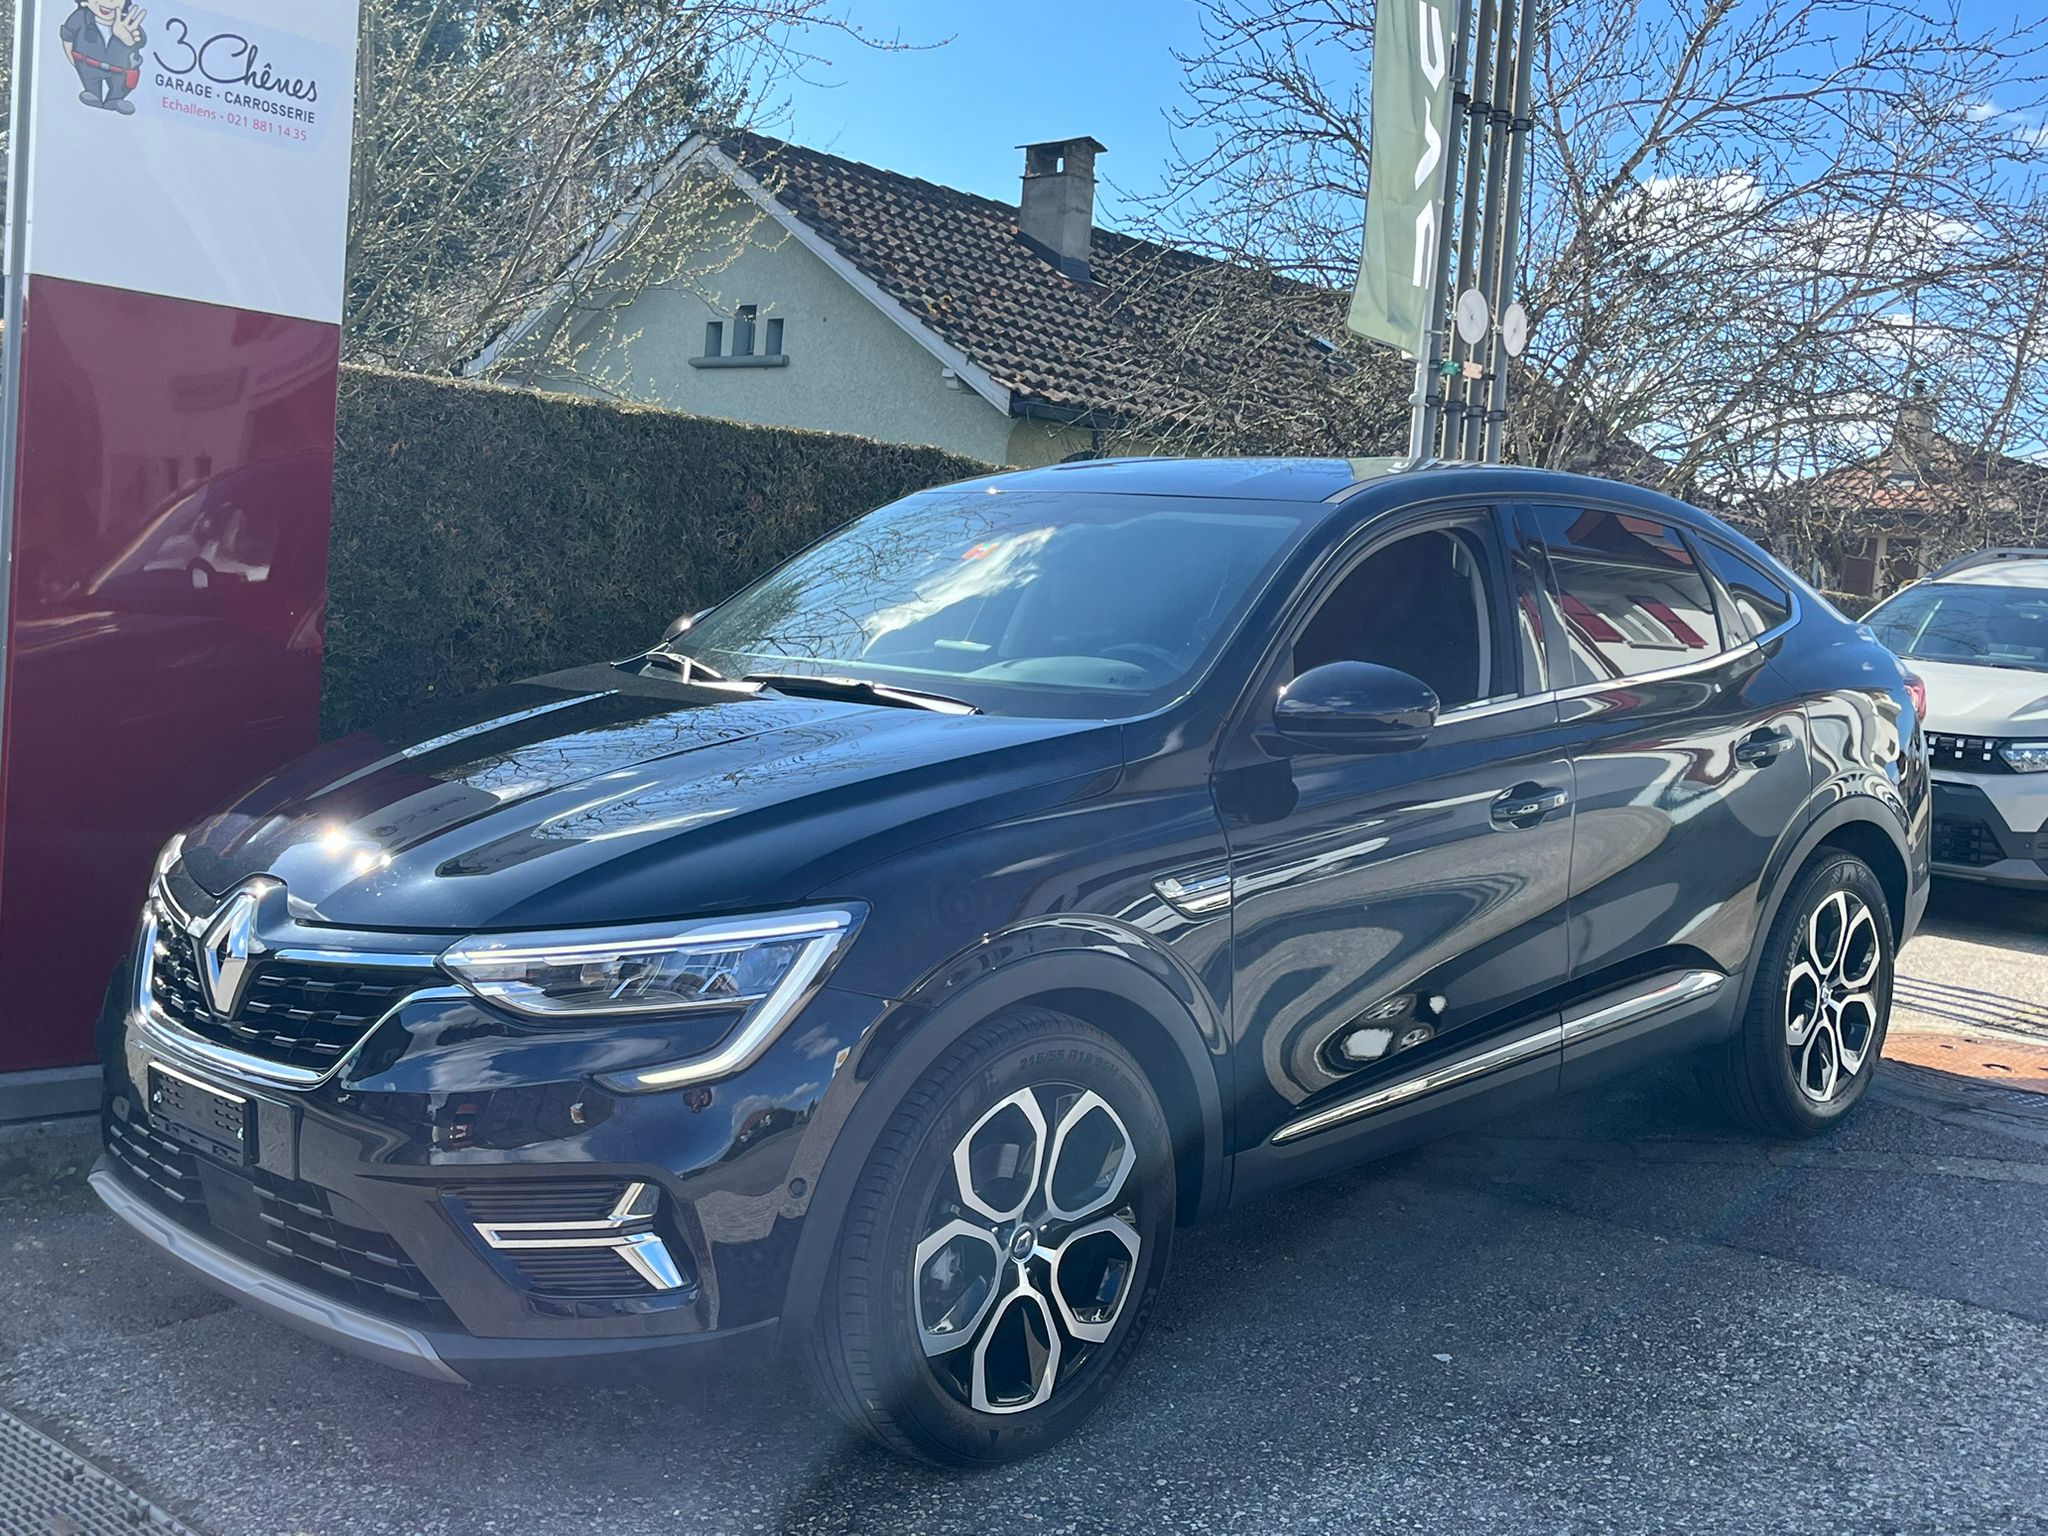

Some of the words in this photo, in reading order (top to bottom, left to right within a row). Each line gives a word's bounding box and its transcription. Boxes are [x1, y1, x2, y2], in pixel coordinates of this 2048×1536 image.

[155, 74, 212, 98] GARAGE
[224, 91, 315, 124] CARROSSERIE
[161, 97, 217, 120] Echallens
[227, 113, 248, 127] 021
[252, 119, 273, 133] 881
